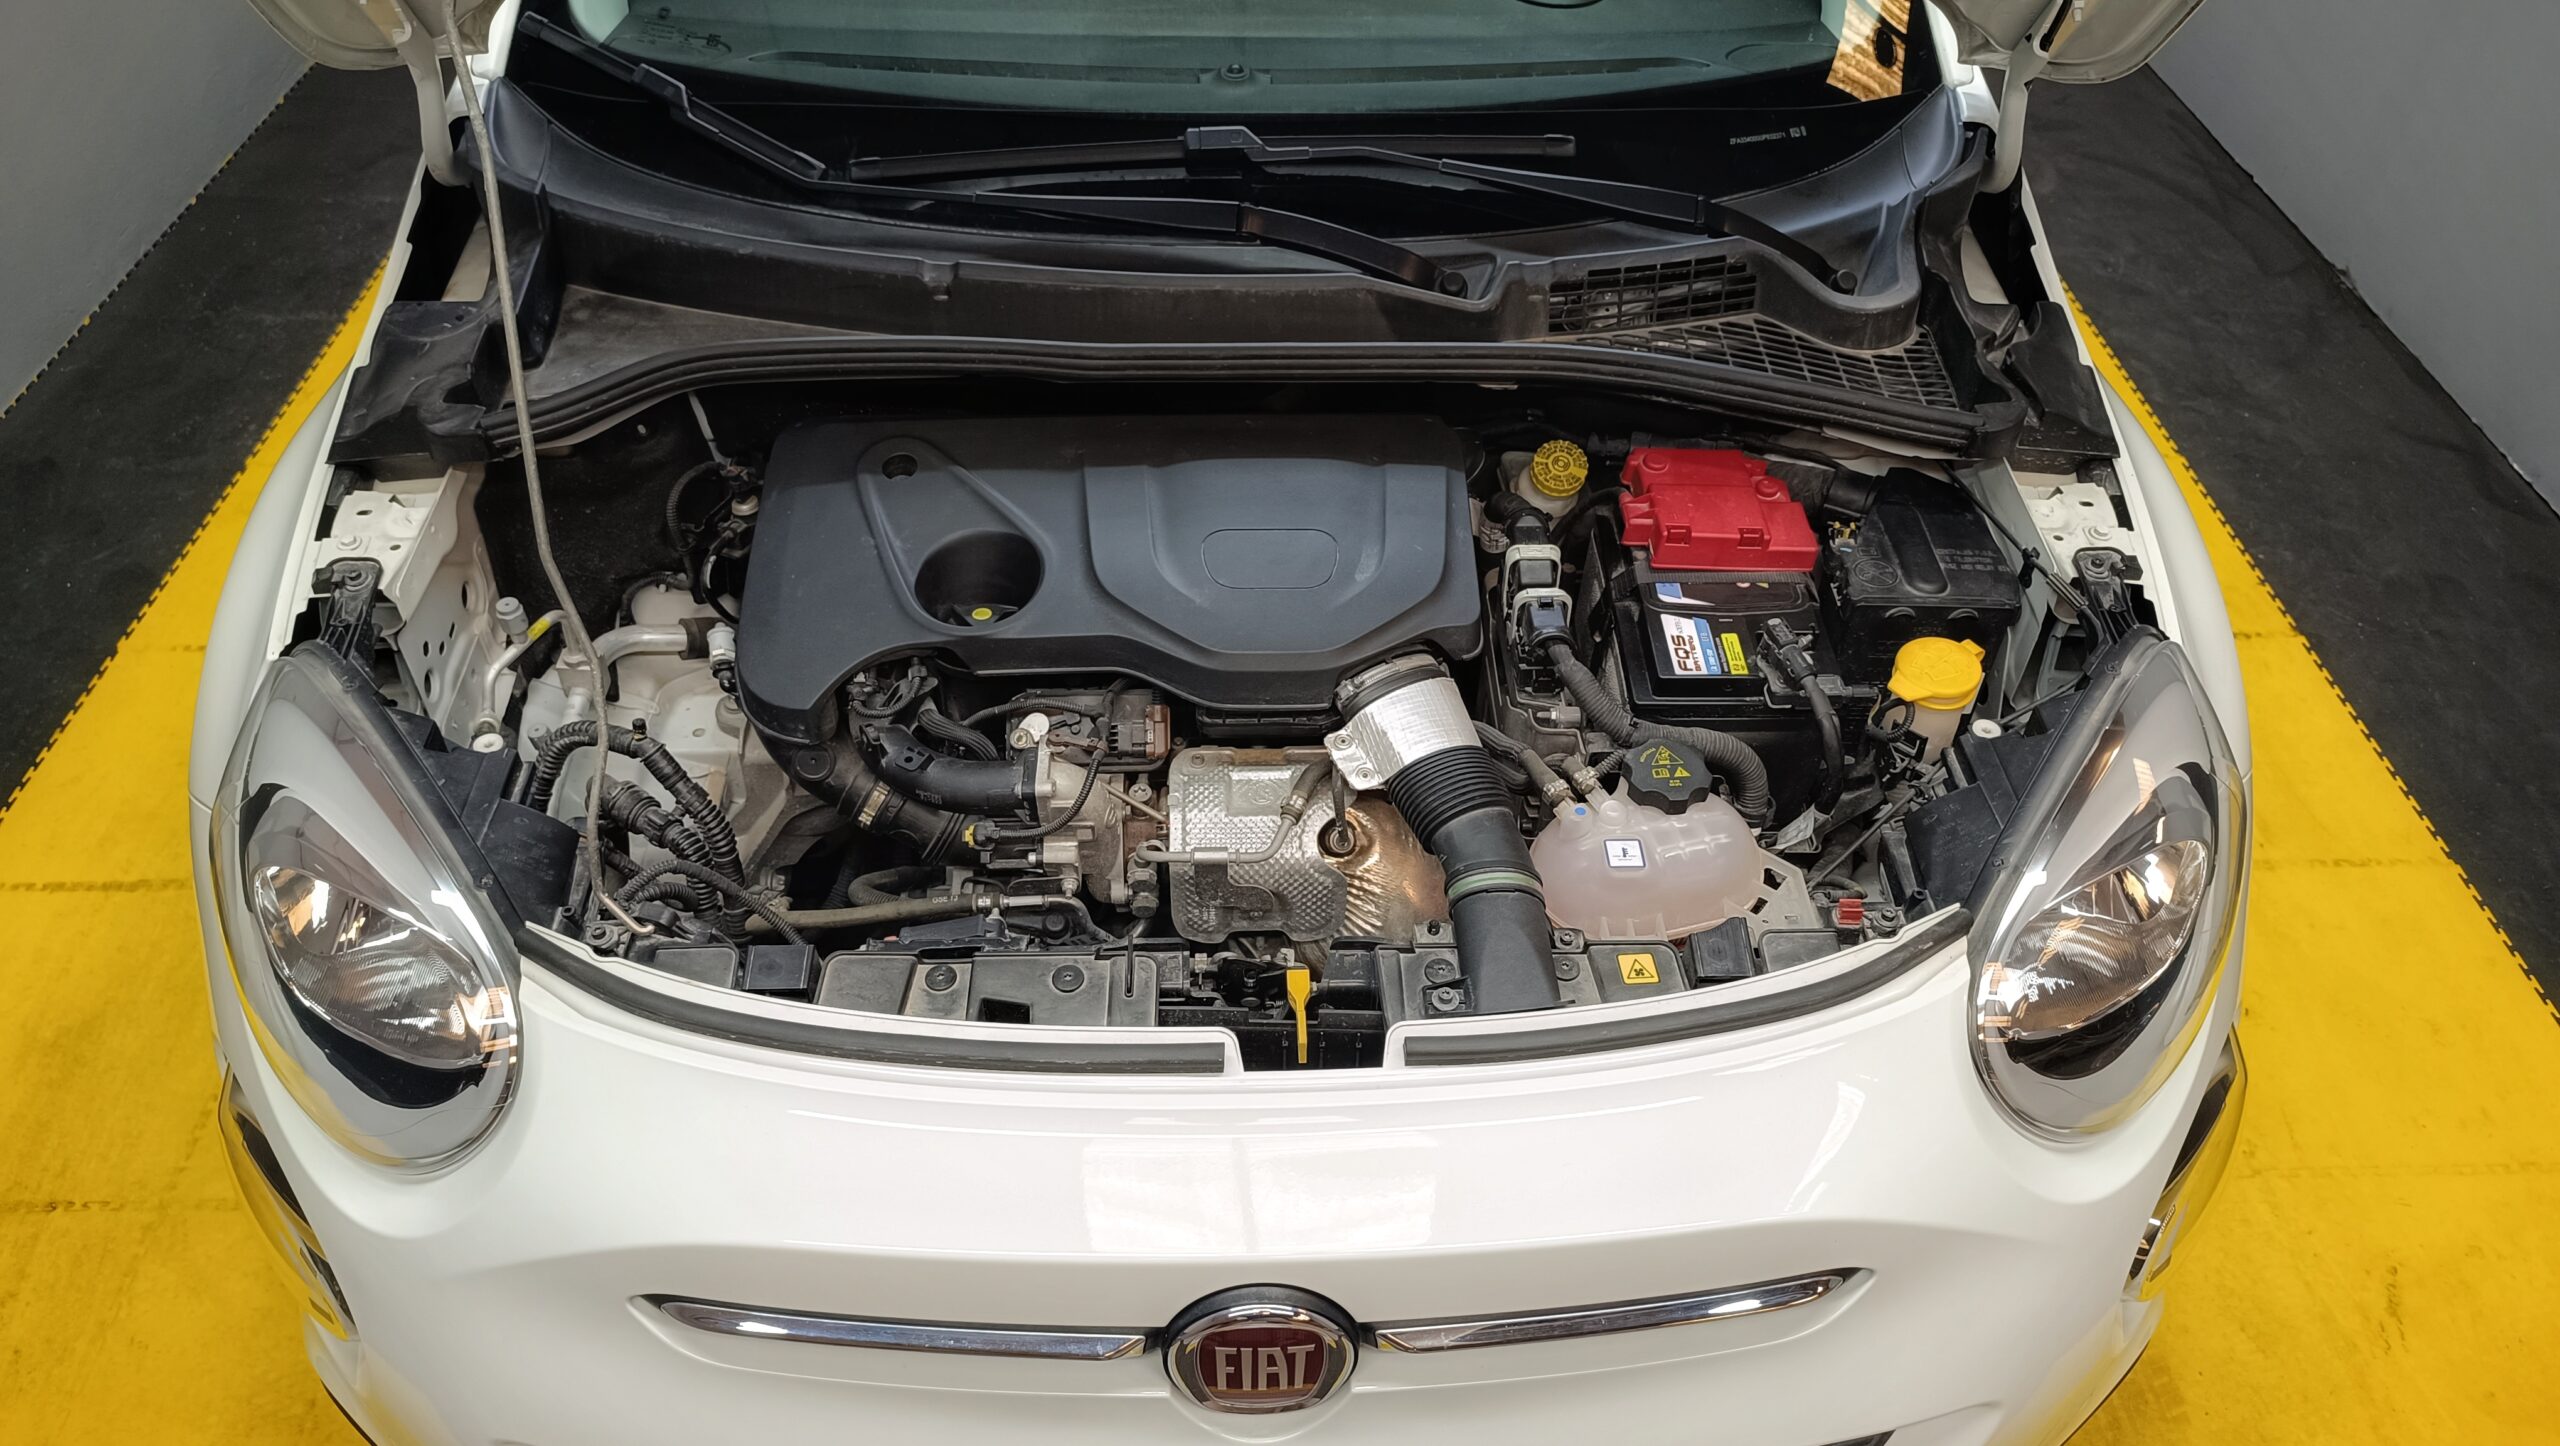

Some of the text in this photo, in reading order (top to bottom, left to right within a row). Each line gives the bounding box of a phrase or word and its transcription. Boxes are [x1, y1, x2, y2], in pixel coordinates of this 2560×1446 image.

[1671, 634, 1693, 671] FQS
[1687, 635, 1702, 671] BATTERY
[1215, 1343, 1315, 1391] FIAT
